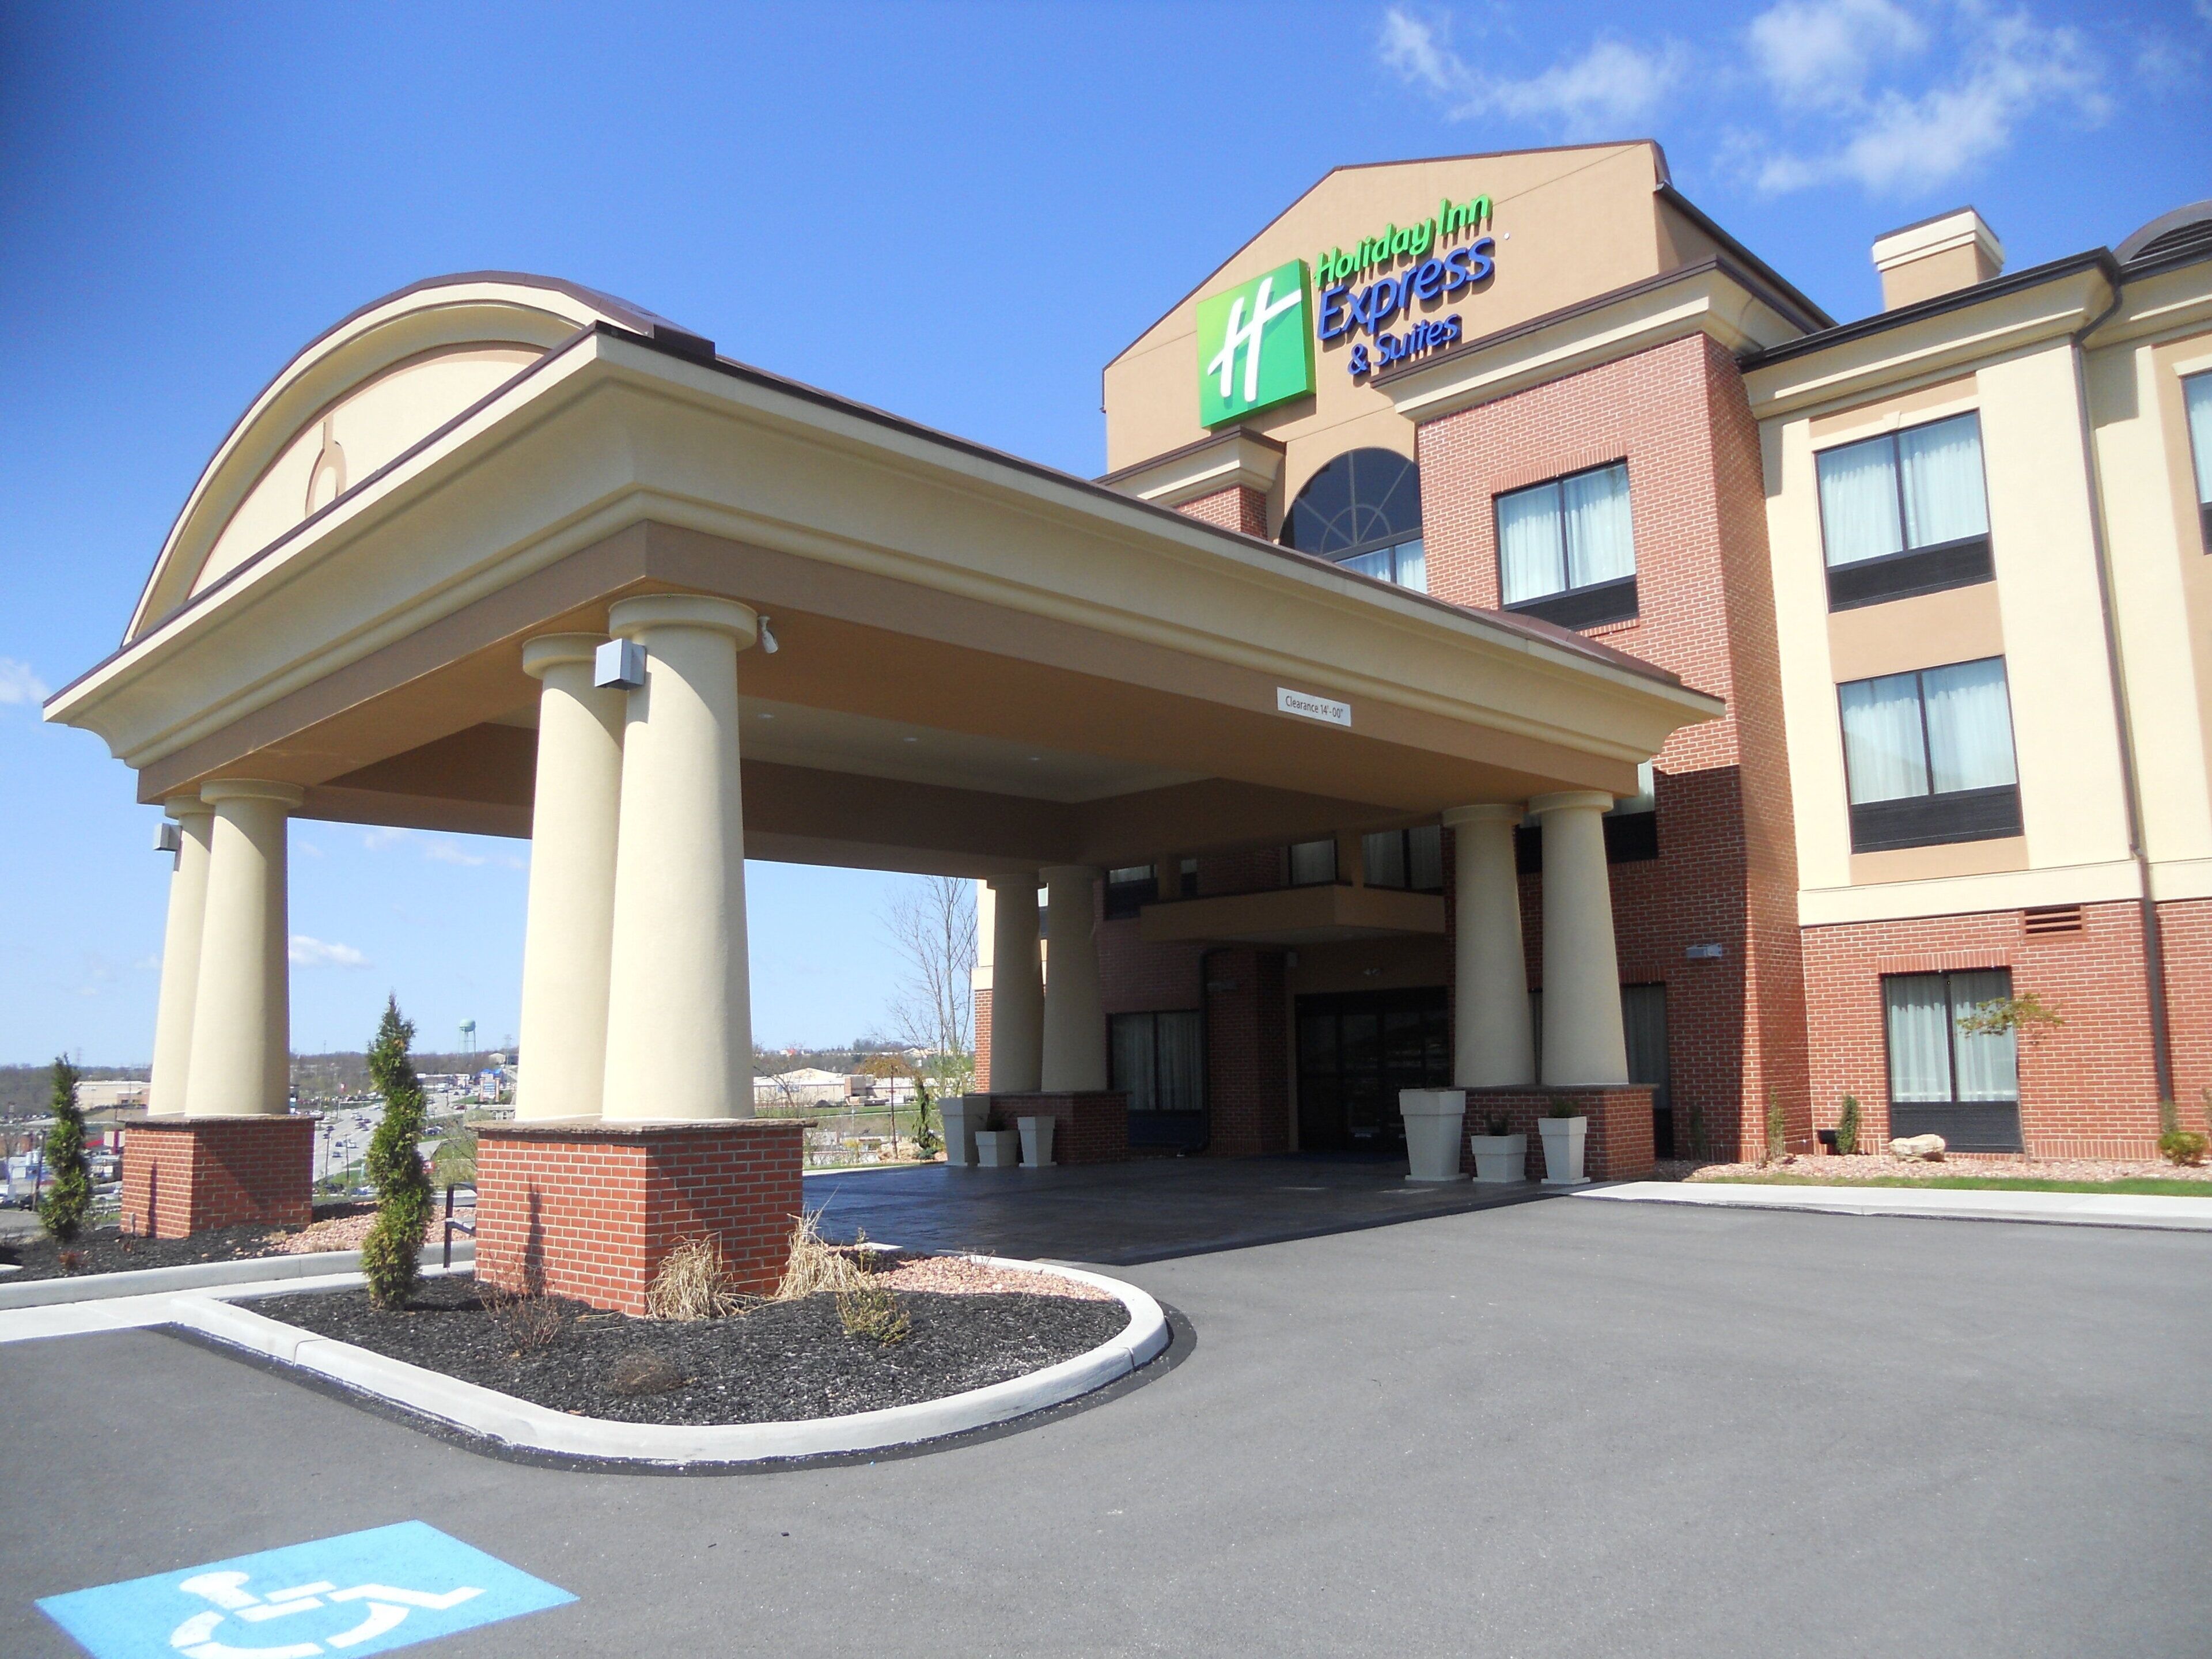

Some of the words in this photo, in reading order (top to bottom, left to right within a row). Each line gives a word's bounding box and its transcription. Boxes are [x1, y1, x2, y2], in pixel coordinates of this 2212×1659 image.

[1313, 217, 1435, 289] Holiday
[1437, 194, 1493, 236] Inn
[1317, 237, 1495, 341] Express
[1348, 343, 1371, 376] &
[1374, 313, 1463, 367] Suites
[1285, 695, 1319, 714] Clearance
